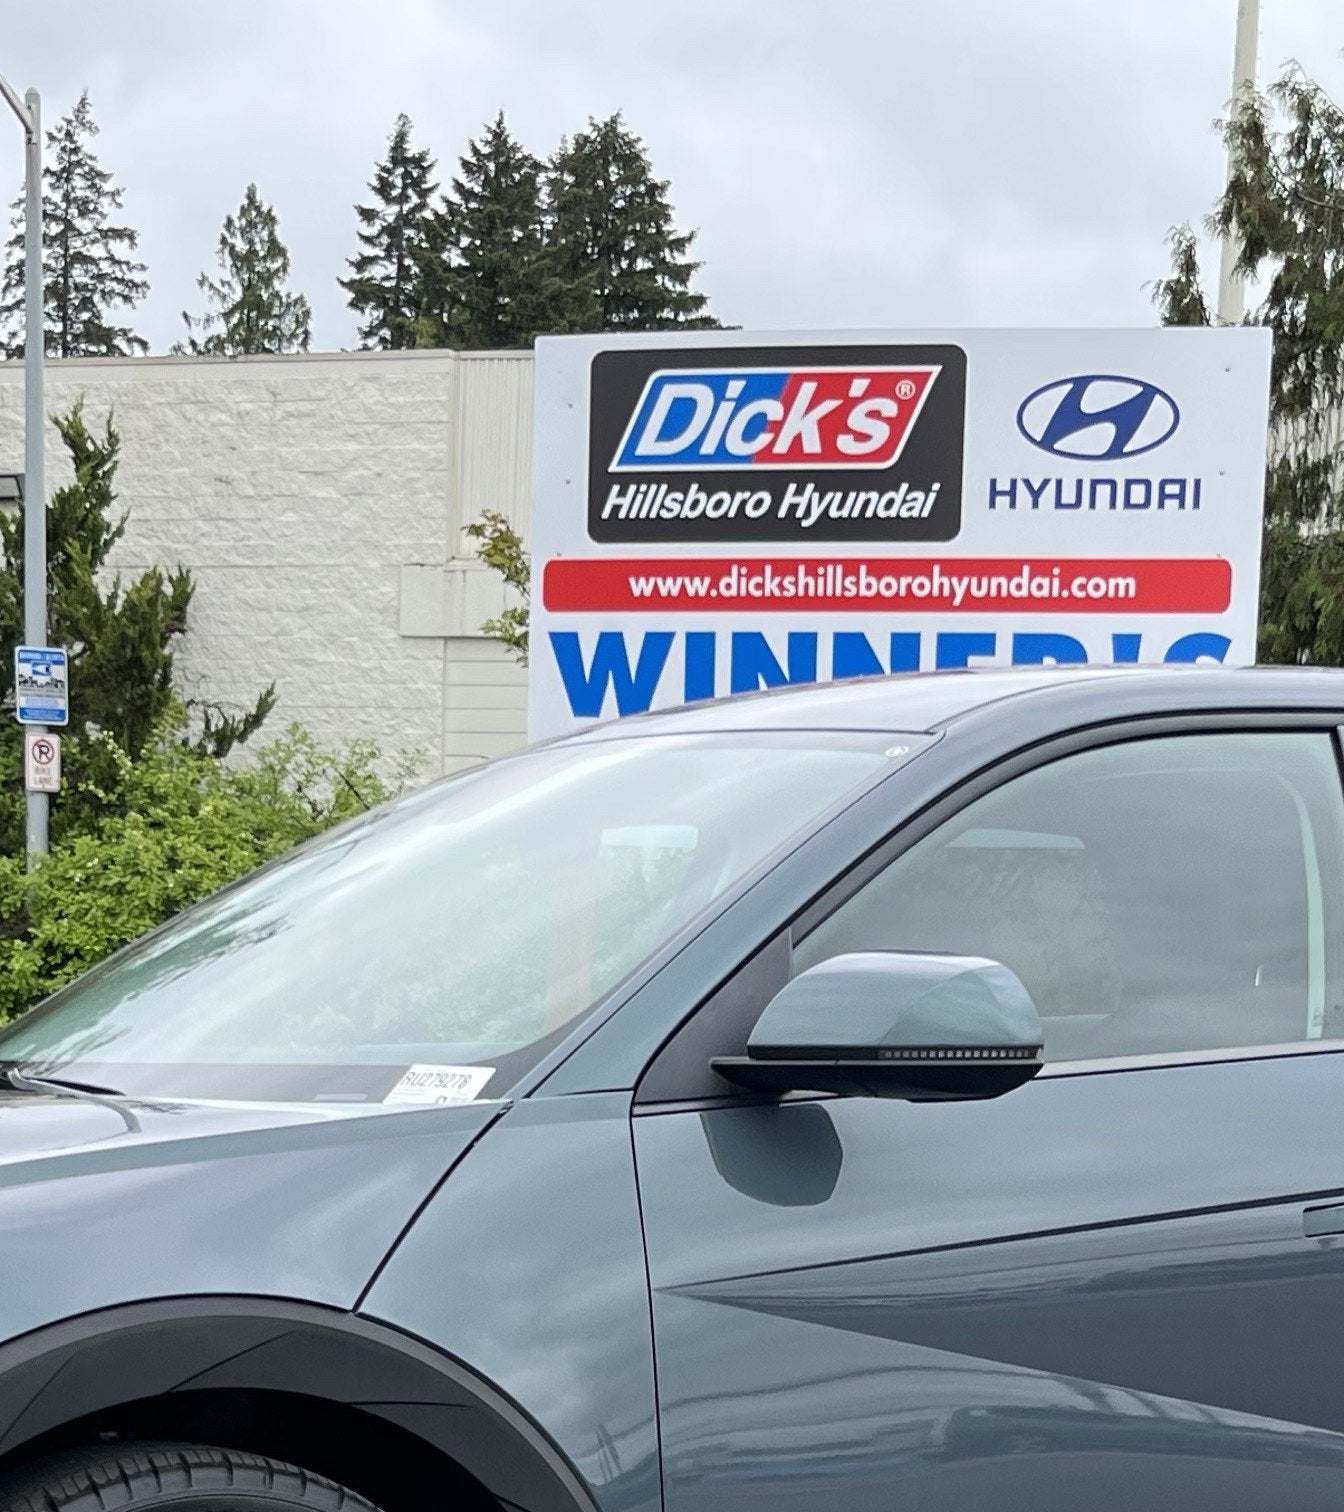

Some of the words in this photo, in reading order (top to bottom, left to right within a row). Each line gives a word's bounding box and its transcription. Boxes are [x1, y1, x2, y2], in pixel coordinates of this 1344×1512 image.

[601, 482, 773, 519] Hillsboro
[776, 482, 942, 528] Hyundai
[989, 477, 1202, 510] HYUNDAI
[628, 564, 1137, 607] www.dickshillsborohyundai.com
